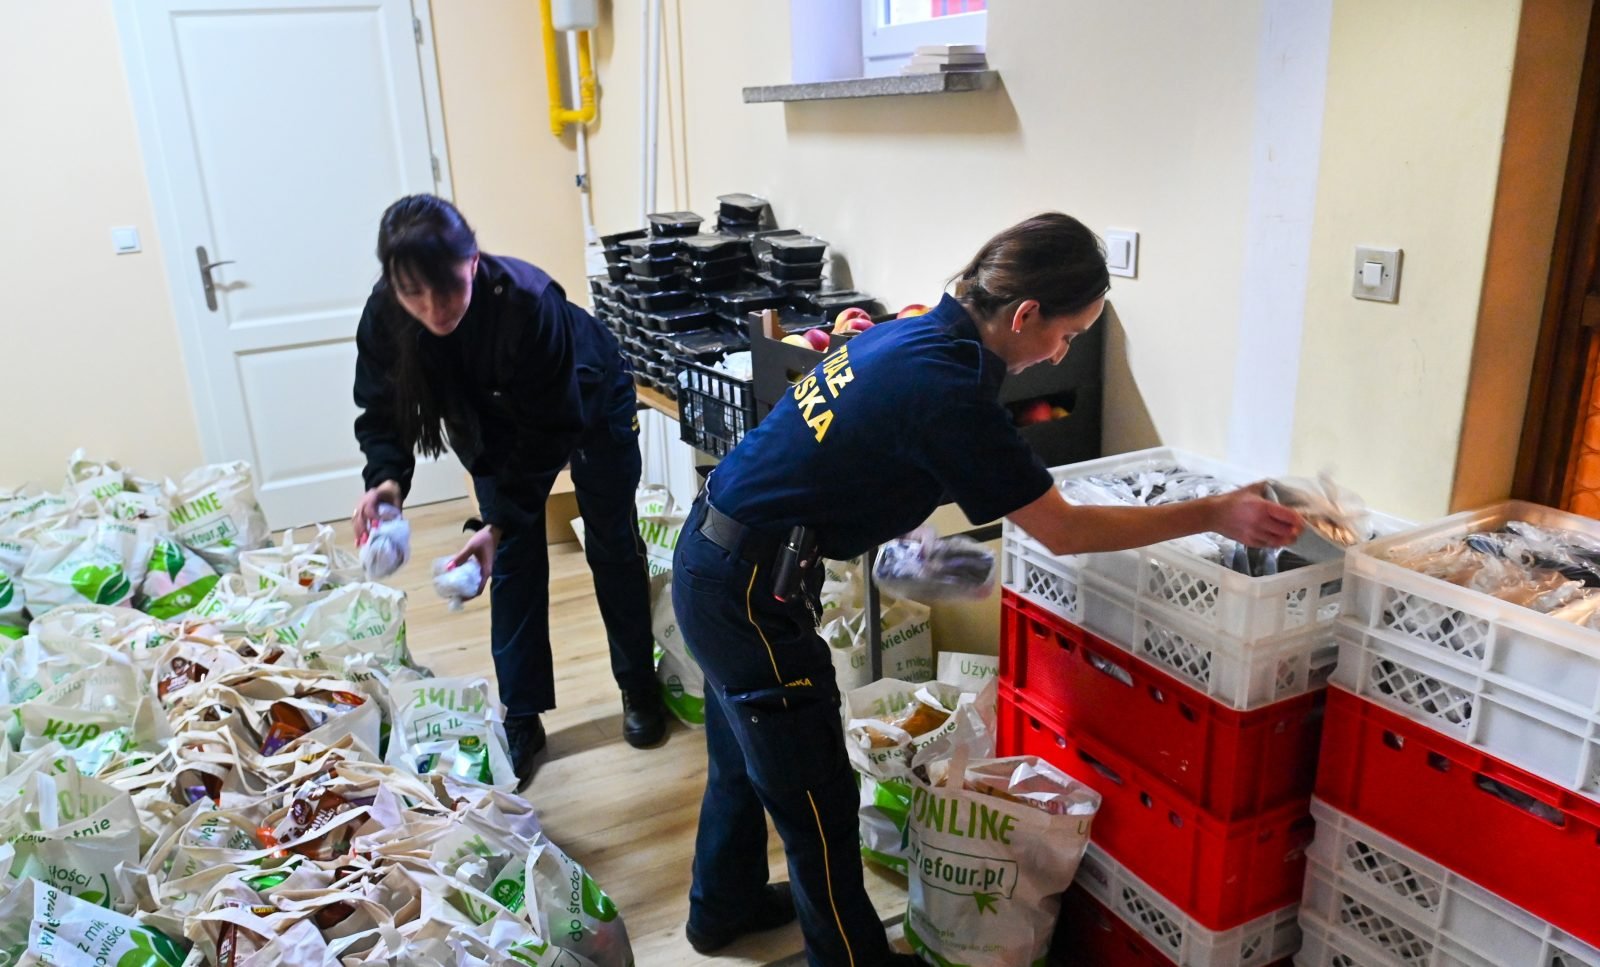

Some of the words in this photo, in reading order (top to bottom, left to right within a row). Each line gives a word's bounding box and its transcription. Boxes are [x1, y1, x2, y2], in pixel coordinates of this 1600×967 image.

[792, 371, 834, 443] SKA
[70, 818, 111, 842] tnie
[912, 786, 1020, 845] ONLINE
[568, 919, 583, 942] do
